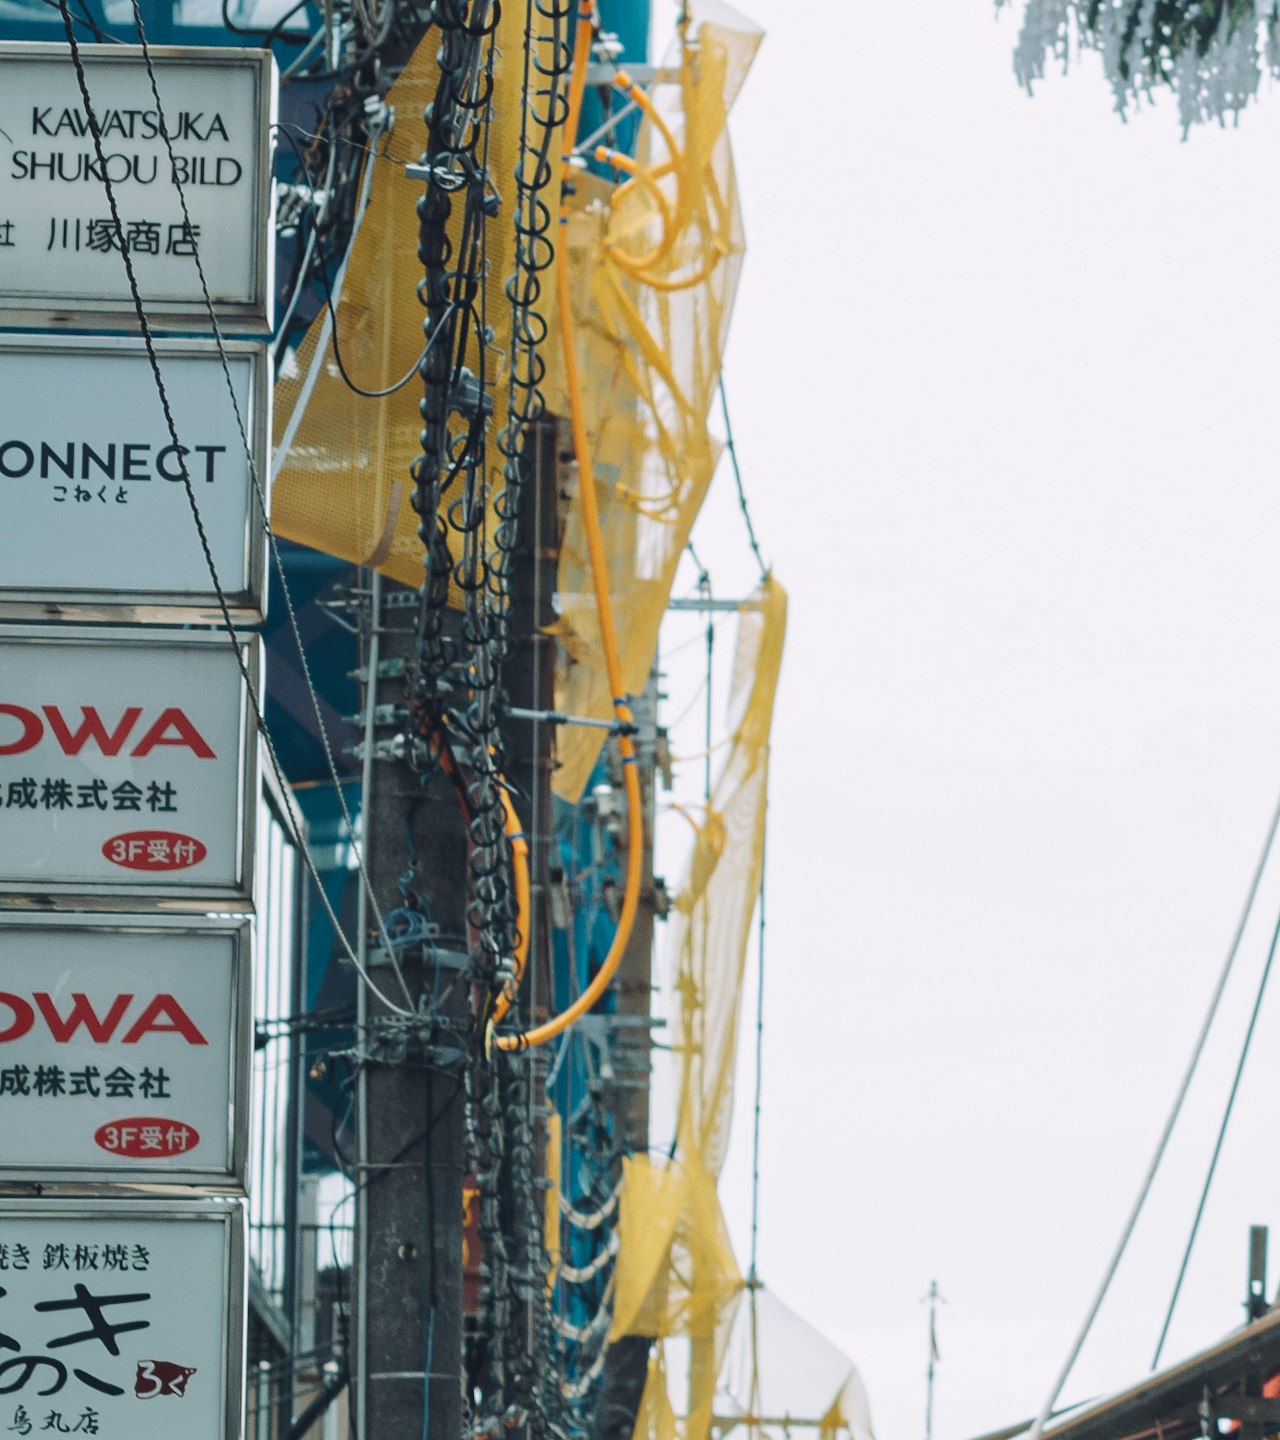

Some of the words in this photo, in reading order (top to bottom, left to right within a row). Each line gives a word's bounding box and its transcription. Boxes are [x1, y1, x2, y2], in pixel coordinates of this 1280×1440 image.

[32, 107, 229, 141] KAWATSUKA
[11, 151, 157, 184] SHUKOU
[171, 156, 242, 186] BILD
[48, 217, 201, 257] 川塚商店
[0, 440, 226, 483] ONNECT
[53, 485, 128, 504] こねくと
[0, 777, 177, 812] 成株式会社
[112, 840, 197, 864] 3F受付
[0, 1064, 170, 1099] 成株式会社
[104, 1126, 190, 1151] 3F受付
[42, 1243, 150, 1271] 鉄板焼き
